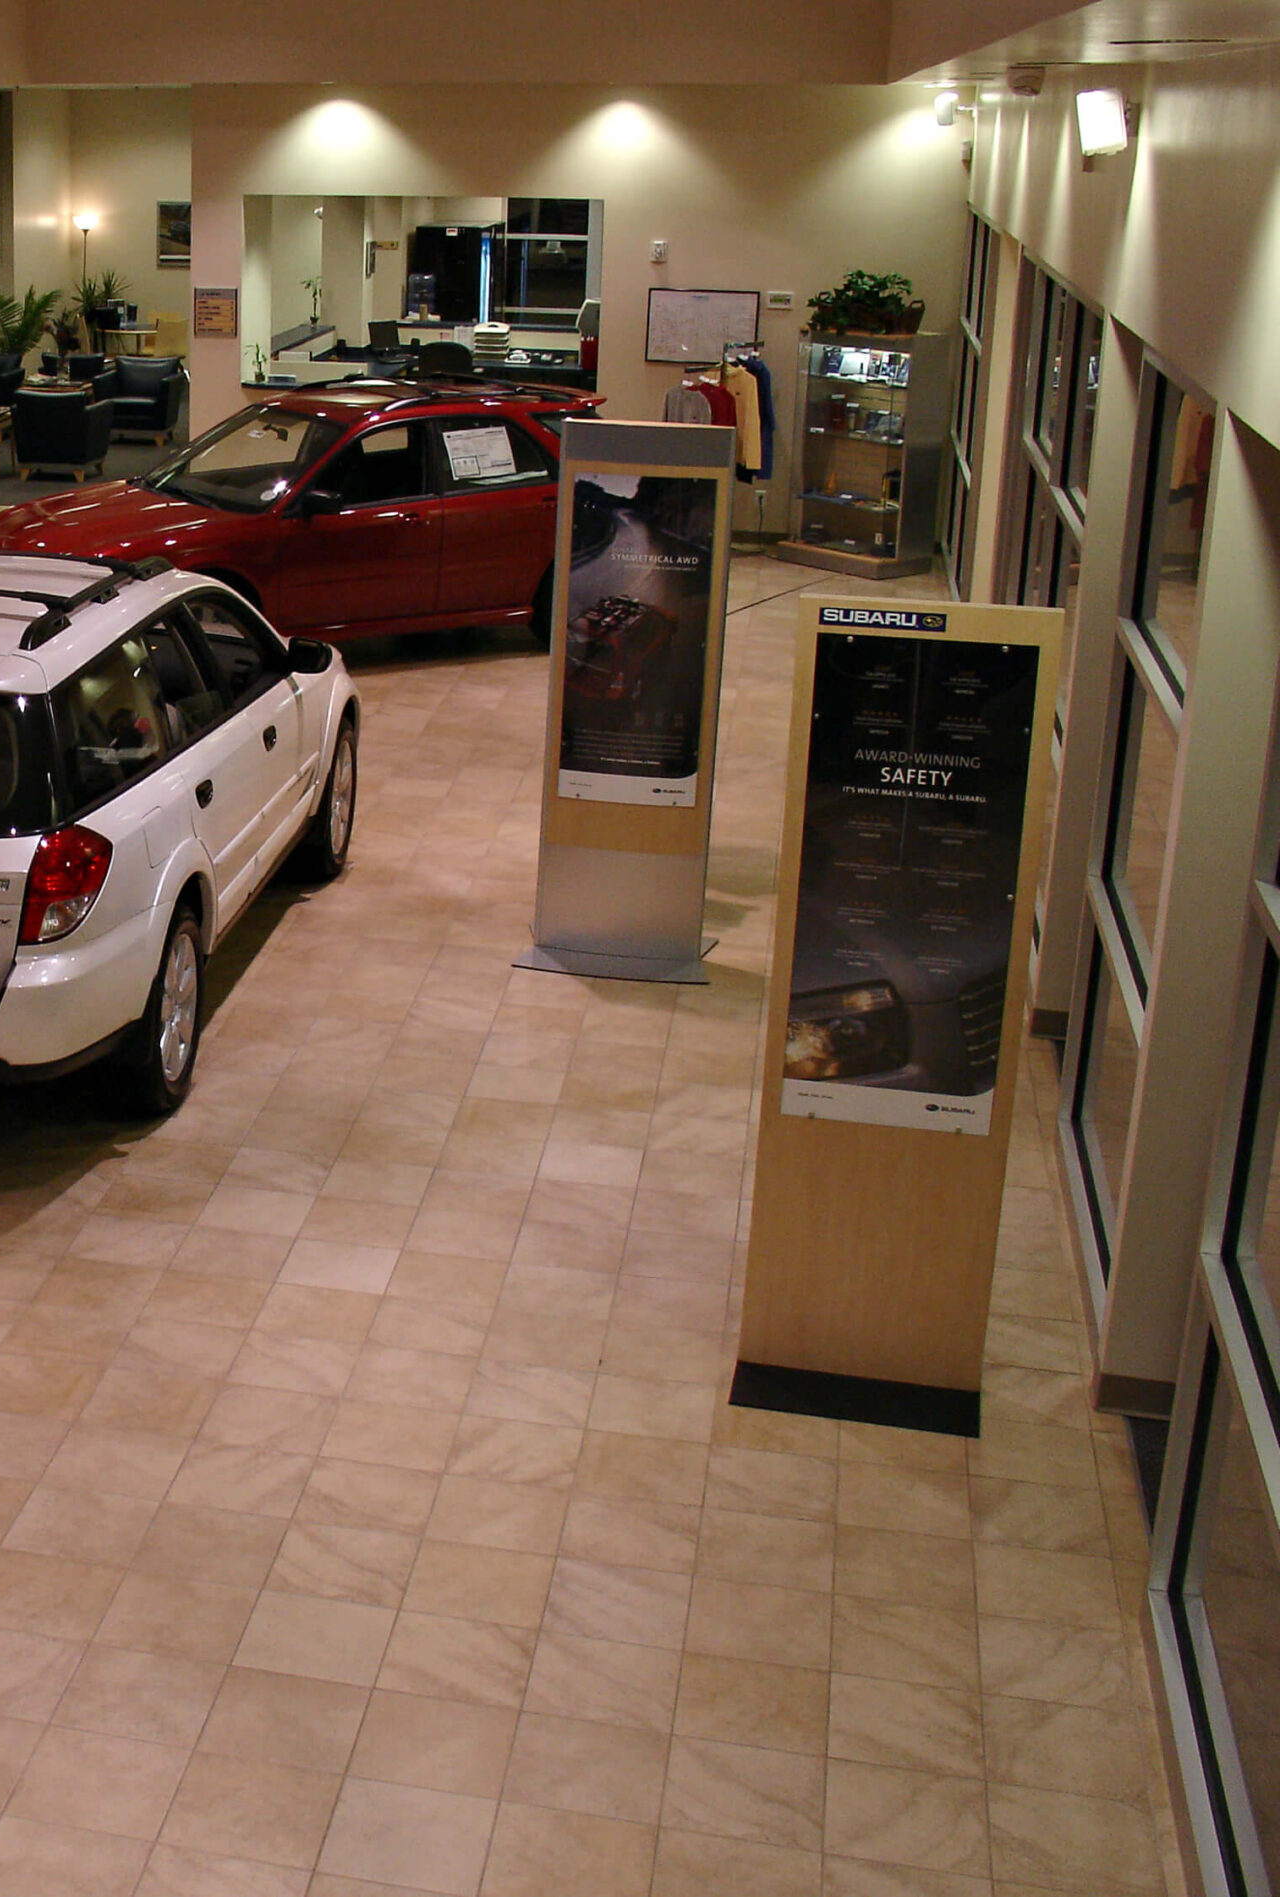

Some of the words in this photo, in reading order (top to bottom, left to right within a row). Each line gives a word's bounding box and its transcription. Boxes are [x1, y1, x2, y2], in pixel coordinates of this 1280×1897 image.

[610, 553, 674, 564] SYMMETRICAL
[676, 557, 699, 565] AWD
[823, 608, 918, 627] SUBARU
[854, 748, 982, 769] AWARD-WINNING
[880, 766, 953, 787] SAFETY
[857, 787, 880, 796] WHAT
[881, 788, 907, 798] MAKES
